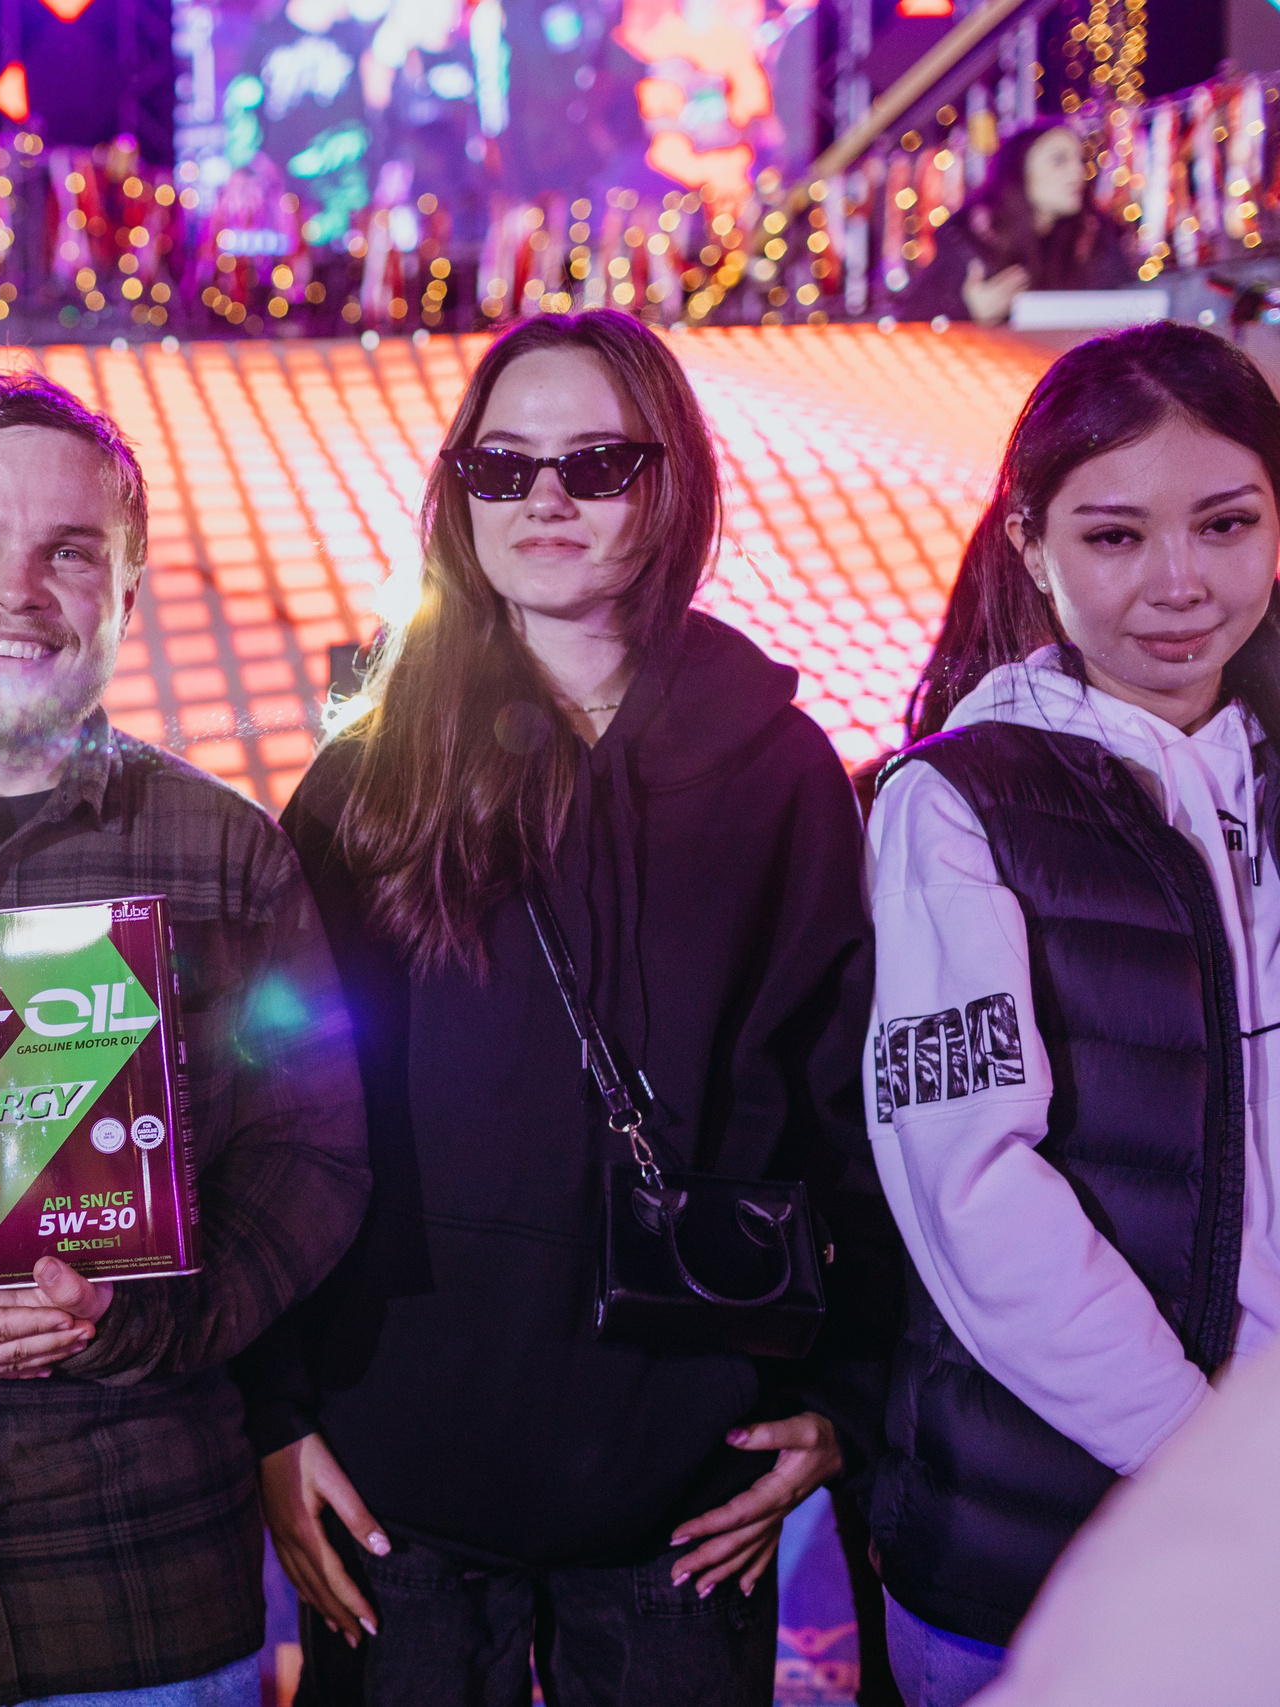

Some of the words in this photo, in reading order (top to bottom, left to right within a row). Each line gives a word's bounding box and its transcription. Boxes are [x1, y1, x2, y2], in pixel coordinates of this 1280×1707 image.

[111, 905, 150, 919] olube
[16, 1041, 72, 1055] GASOLINE
[74, 1037, 119, 1053] MOTOR
[120, 1035, 140, 1047] OIL
[42, 1195, 71, 1212] API
[80, 1191, 134, 1209] SN/CF
[37, 1207, 136, 1236] 5W-30
[56, 1236, 122, 1252] dexos1
